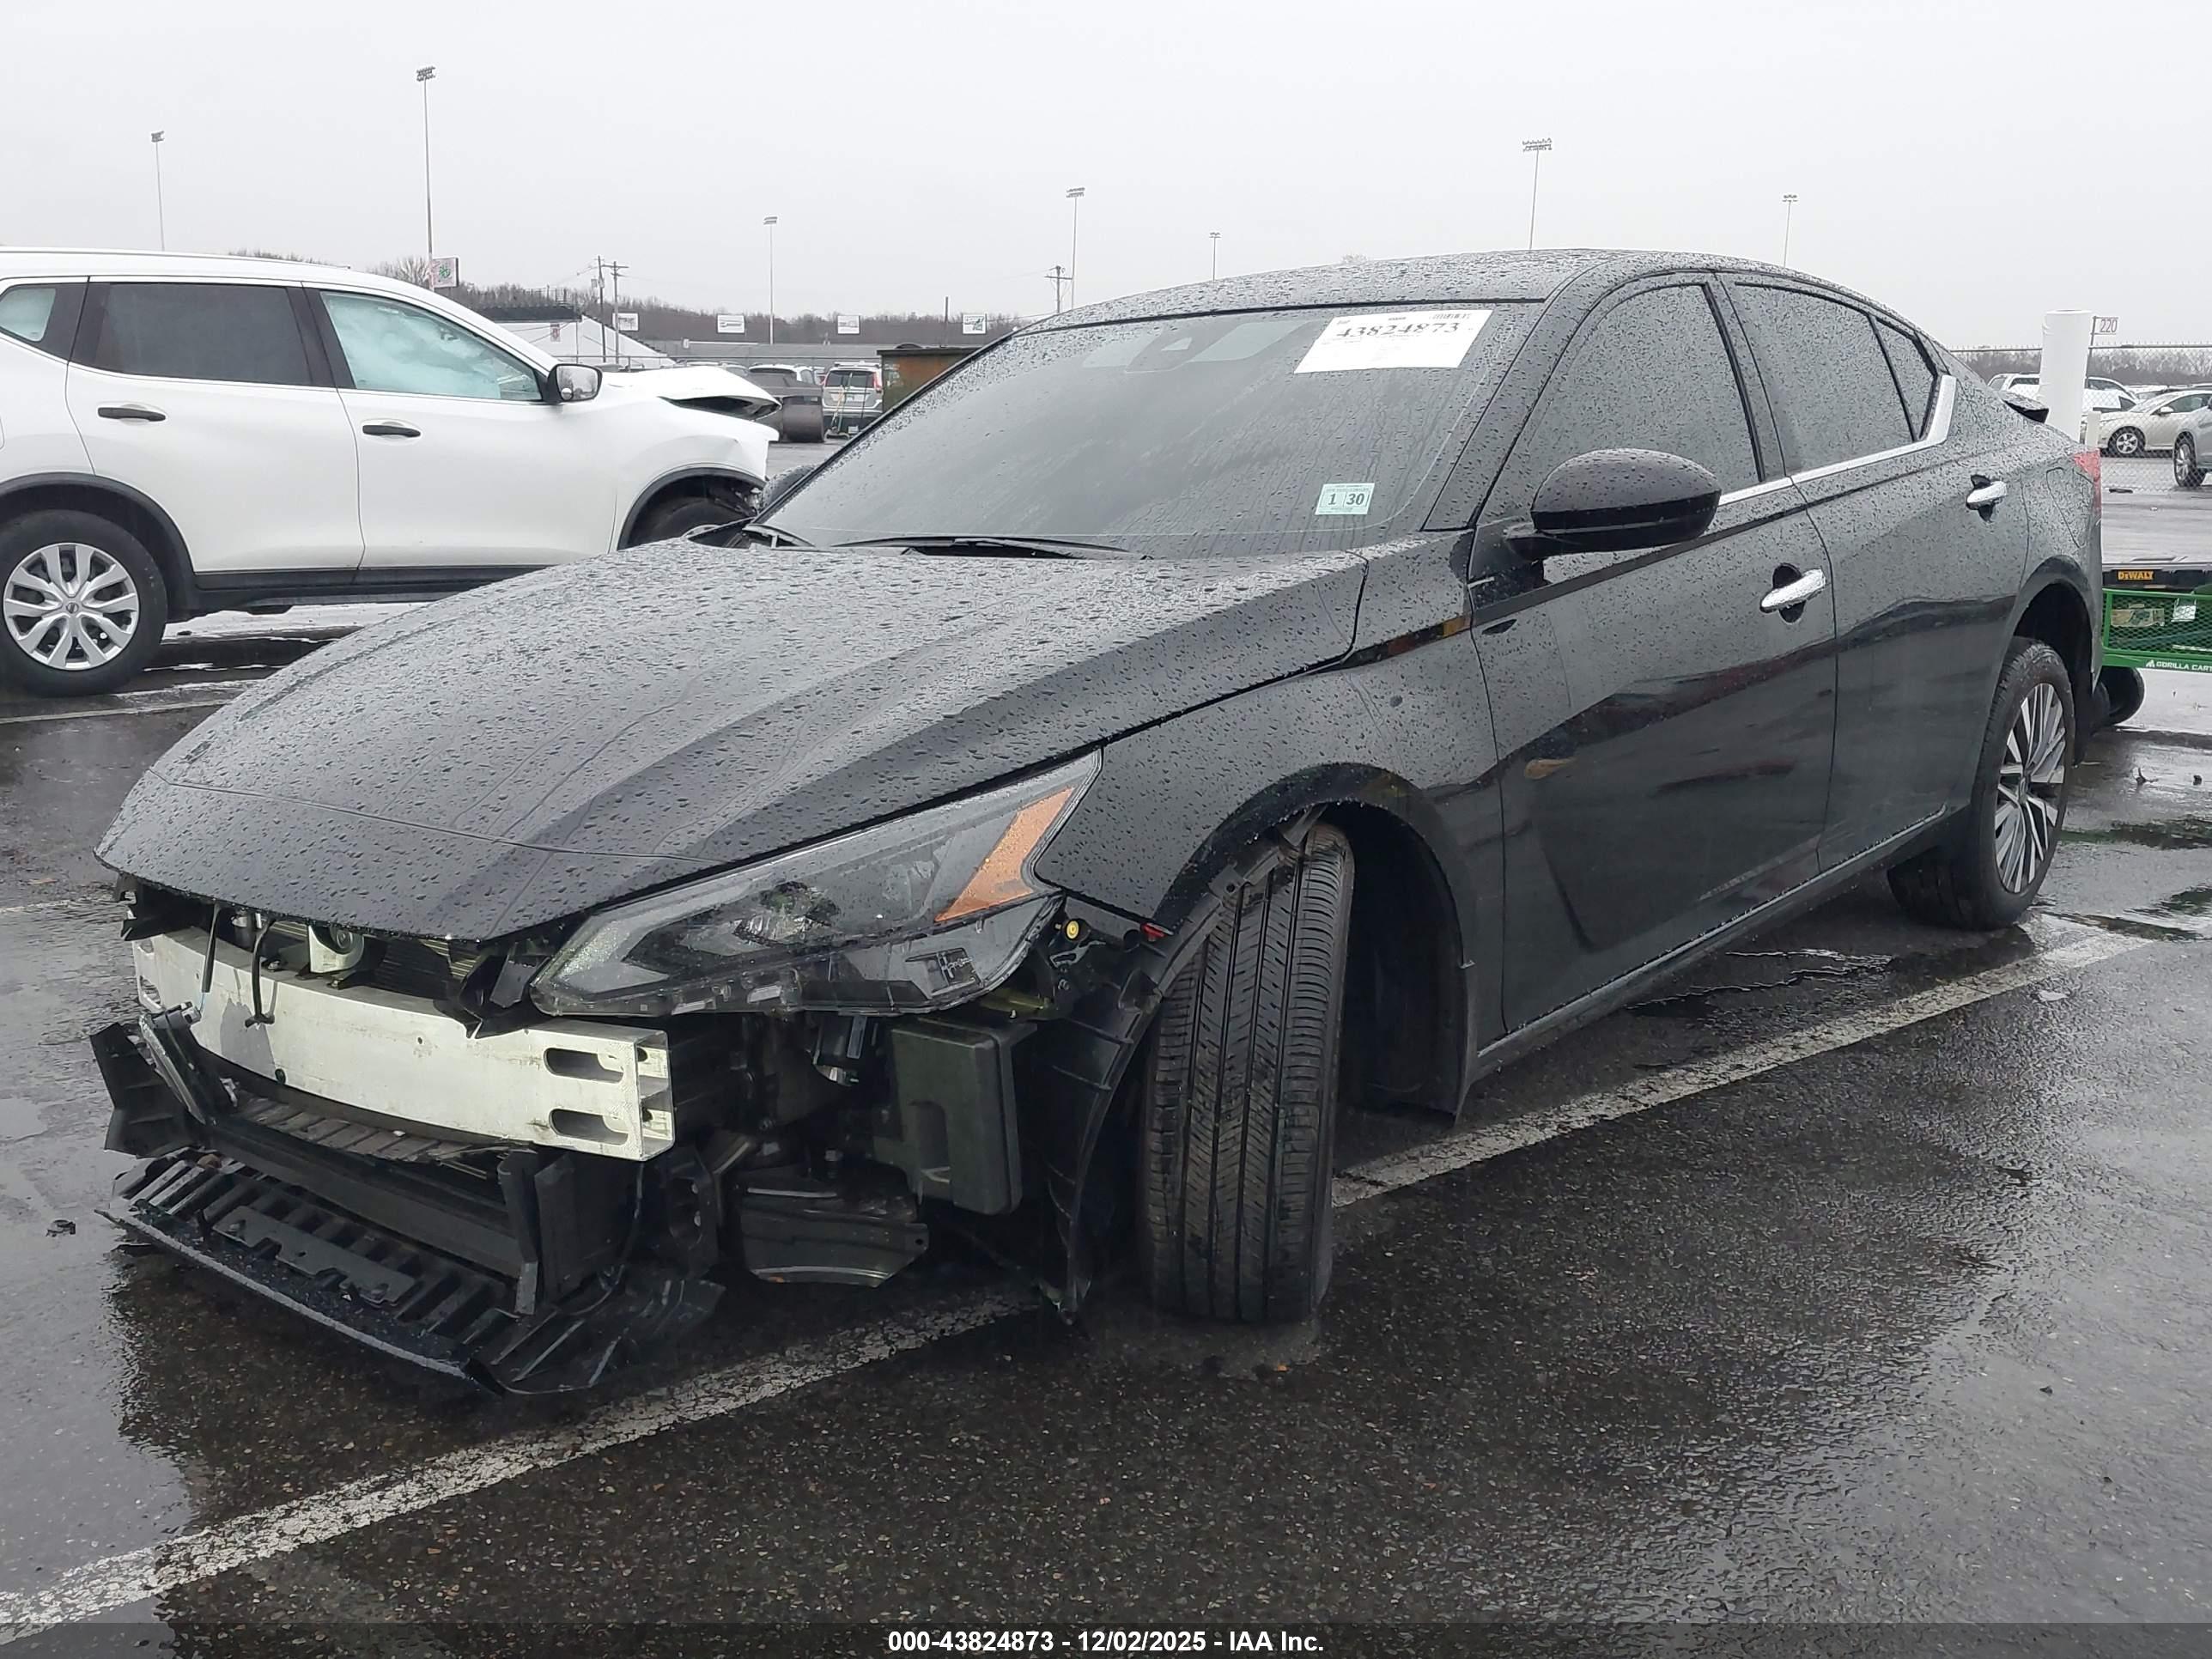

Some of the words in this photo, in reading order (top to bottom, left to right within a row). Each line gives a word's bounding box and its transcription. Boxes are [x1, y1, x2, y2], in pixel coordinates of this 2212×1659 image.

[1336, 322, 1461, 337] 43824873
[2100, 319, 2118, 333] 220
[1328, 493, 1337, 506] 1
[1346, 493, 1365, 506] 30
[2155, 660, 2190, 670] GORILLA
